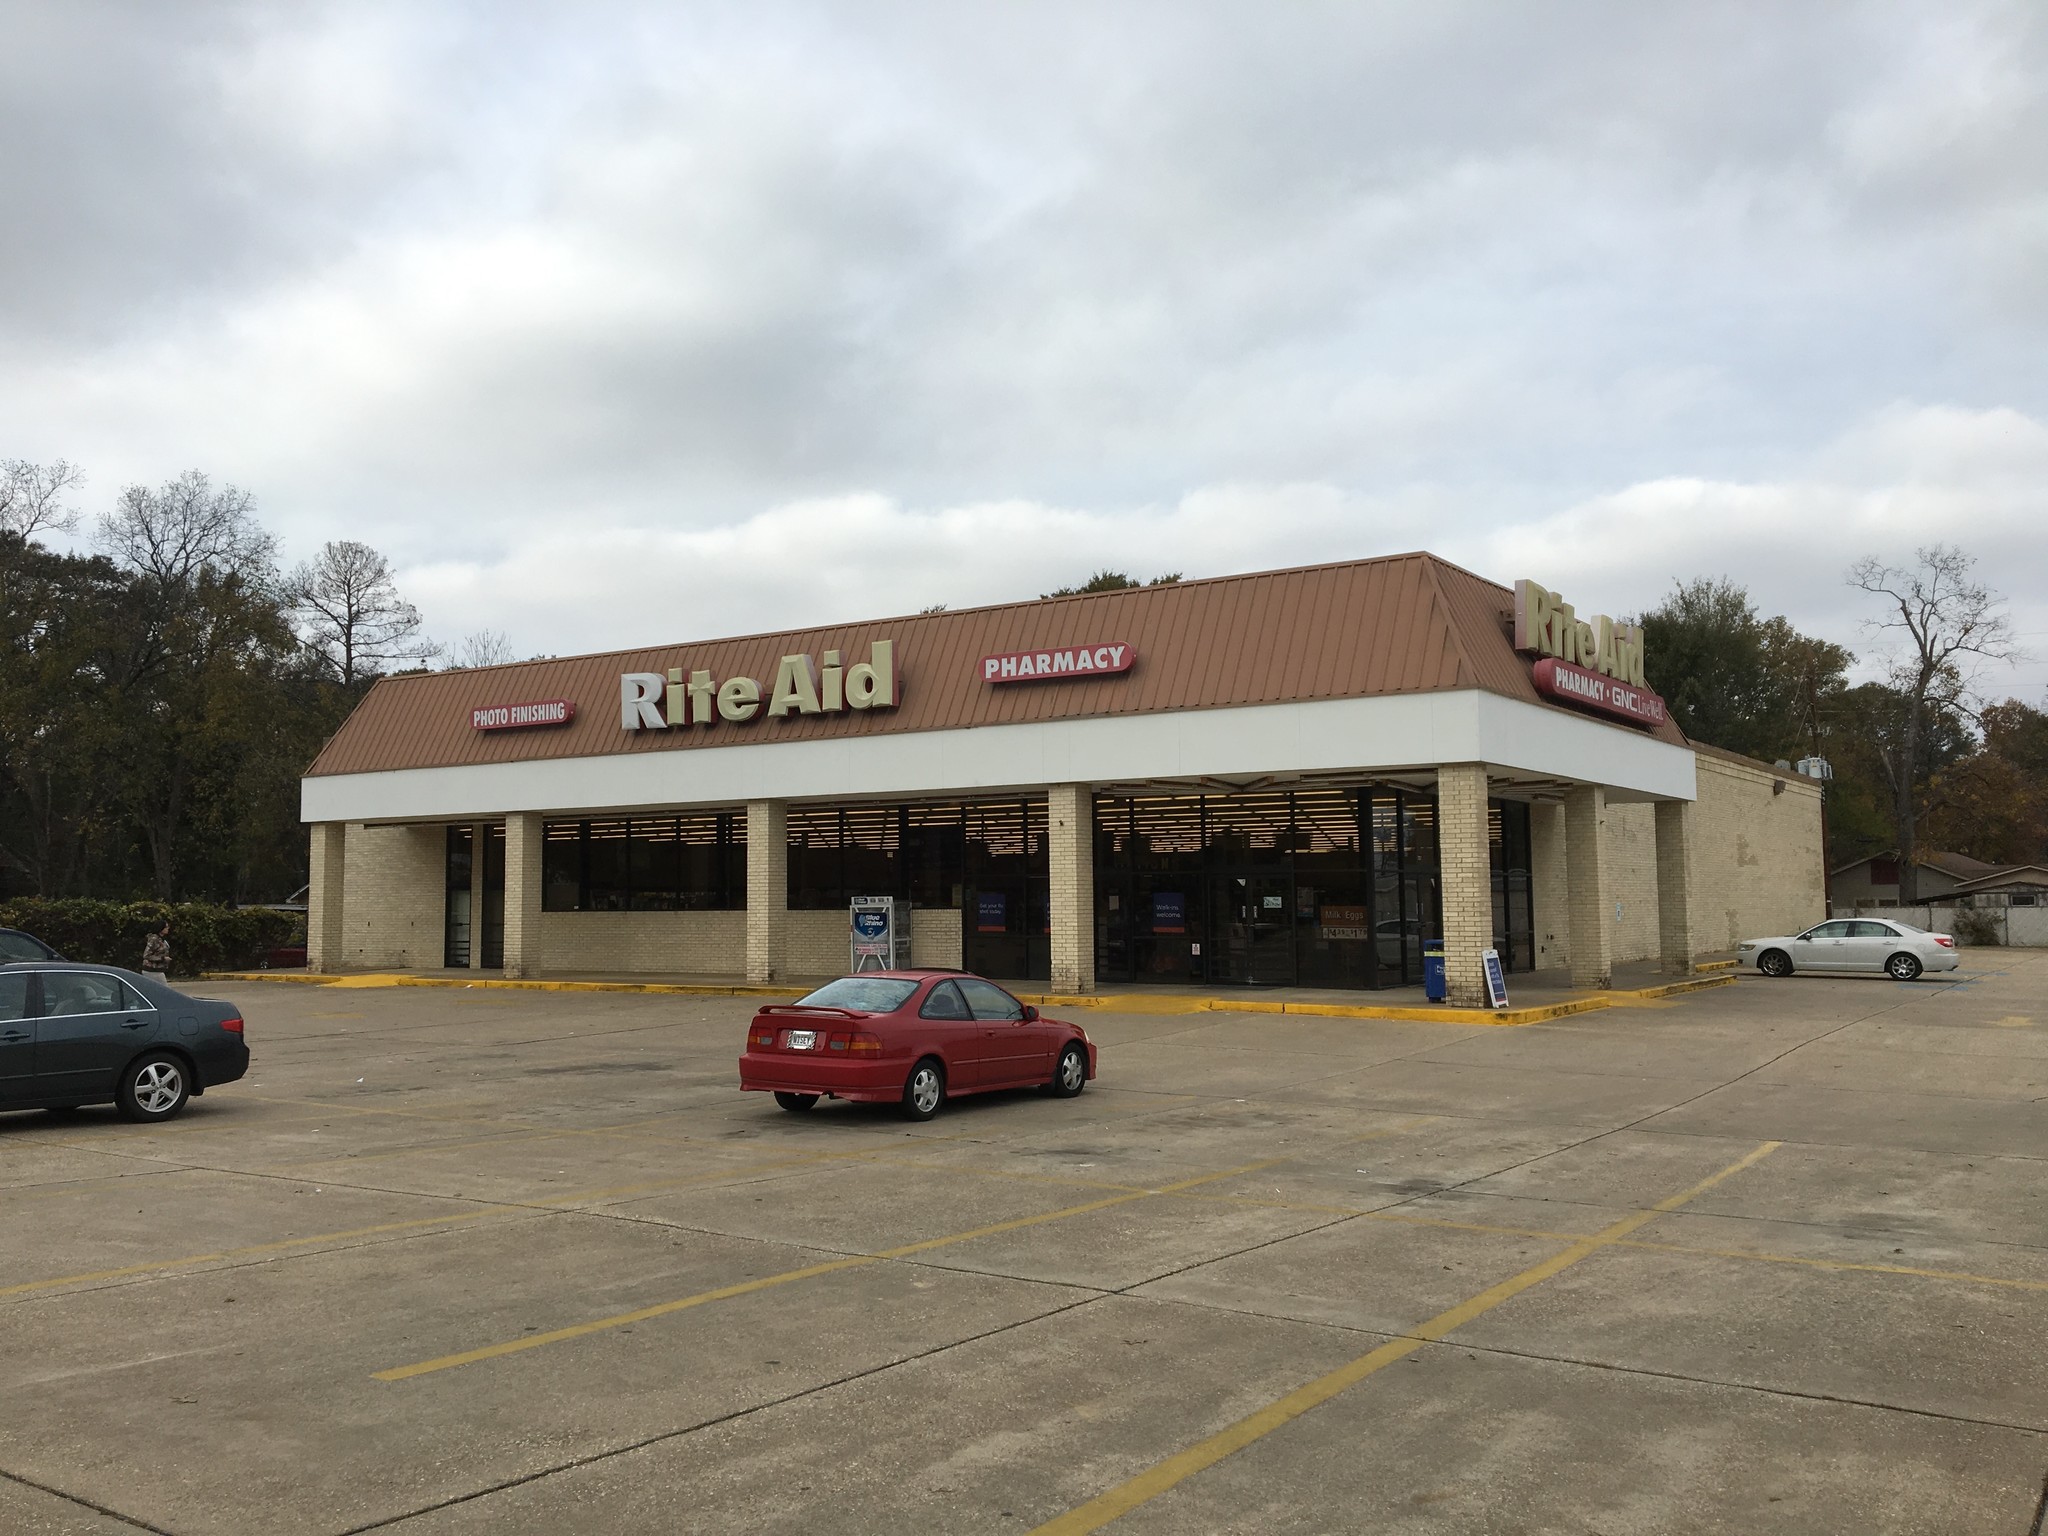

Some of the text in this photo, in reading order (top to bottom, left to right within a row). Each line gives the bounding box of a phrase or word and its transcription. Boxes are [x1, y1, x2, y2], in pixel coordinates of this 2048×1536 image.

[1515, 579, 1645, 688] Rite Aid
[985, 645, 1125, 679] PHARMACY
[621, 639, 897, 729] Rite Aid
[1555, 666, 1605, 702] PHARMACY
[1612, 686, 1638, 712] GNC
[473, 702, 565, 727] PHOTO FINISHING
[1345, 911, 1363, 920] Eggs
